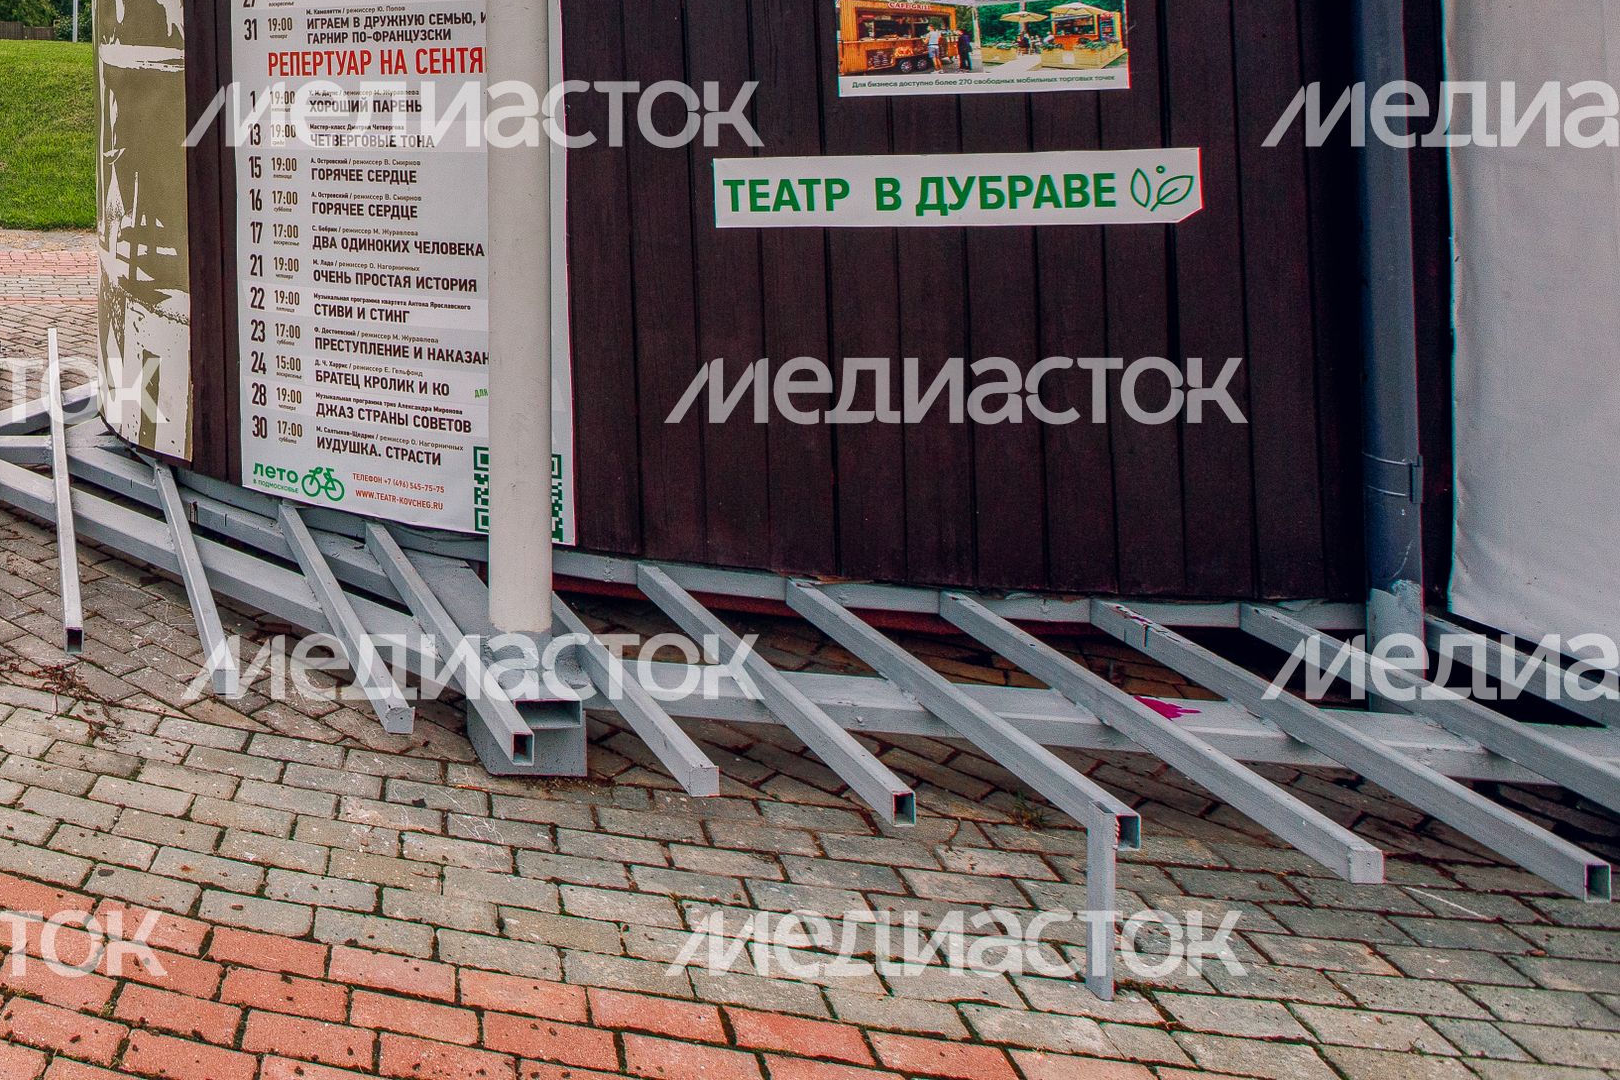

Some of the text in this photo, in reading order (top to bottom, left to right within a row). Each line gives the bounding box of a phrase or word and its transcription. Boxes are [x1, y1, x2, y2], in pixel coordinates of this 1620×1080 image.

[244, 19, 258, 41] 31
[306, 12, 476, 30] ИГРАЕМ В ДРУЖНУЮ СЕМЬЮ,
[307, 28, 452, 45] ГАРНИР ПО-ФРАНЦУЗСКИ
[268, 47, 487, 77] РЕПЕРТУАР НА СЕНТЯ
[852, 80, 866, 90] Для
[867, 80, 898, 88] бизнеса
[899, 79, 933, 89] доступно
[935, 79, 957, 87] более
[959, 78, 972, 86] 270
[973, 77, 1014, 87] свободных
[249, 156, 262, 179] 15
[311, 168, 418, 185] ГОРЯЧЕЕ СЕРДЦЕ
[723, 172, 1117, 217] ТЕАТР В ДУБРАВЕ
[312, 202, 418, 220] ГОРЯЧЕЕ СЕРДЦЕ
[312, 236, 485, 257] ДВА ОДИНОКИХ ЧЕЛОВЕКА
[313, 269, 477, 293] ОЧЕНЬ ПРОСТАЯ ИСТОРИЯ
[314, 303, 410, 323] СТИВИ И СТИНГ
[315, 337, 410, 359] ПРЕСТУПЛЕНИЕ
[414, 346, 422, 360] И
[315, 370, 450, 396] БРАТЕЦ КРОЛИК И КО
[251, 383, 267, 407] 28
[252, 415, 268, 440] 30
[315, 402, 472, 434] ДЖАЗ СТРАНЫ СОВЕТОВ
[316, 436, 442, 466] ИУДУШКА. СТРАСТИ
[253, 461, 299, 485] лето
[353, 472, 445, 494] ТЕЛЕФОН +7 (496) 545-75-75
[355, 489, 444, 511] WWW.TEATR-KOVCHEG.RU
